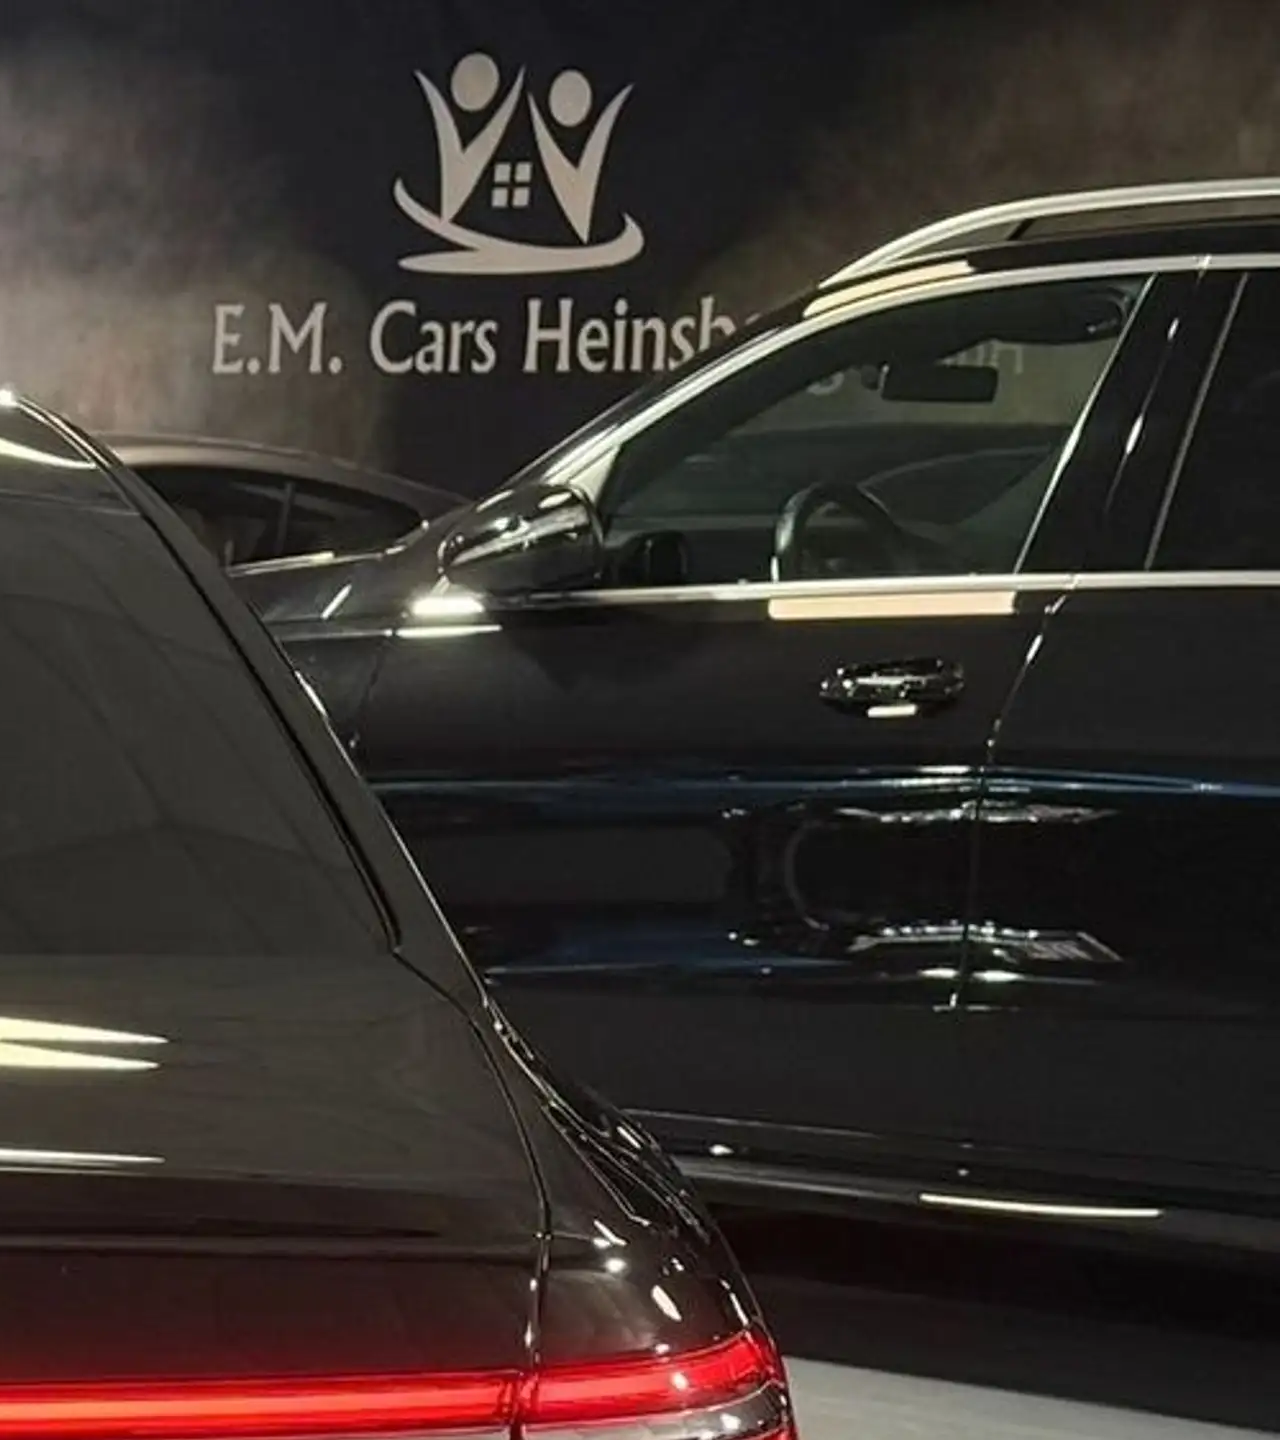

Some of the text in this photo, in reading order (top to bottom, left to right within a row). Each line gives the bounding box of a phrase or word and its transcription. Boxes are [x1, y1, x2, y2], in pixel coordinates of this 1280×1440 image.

[212, 301, 342, 374] E.M.
[370, 299, 498, 374] Cars
[522, 296, 760, 374] Heinsb
